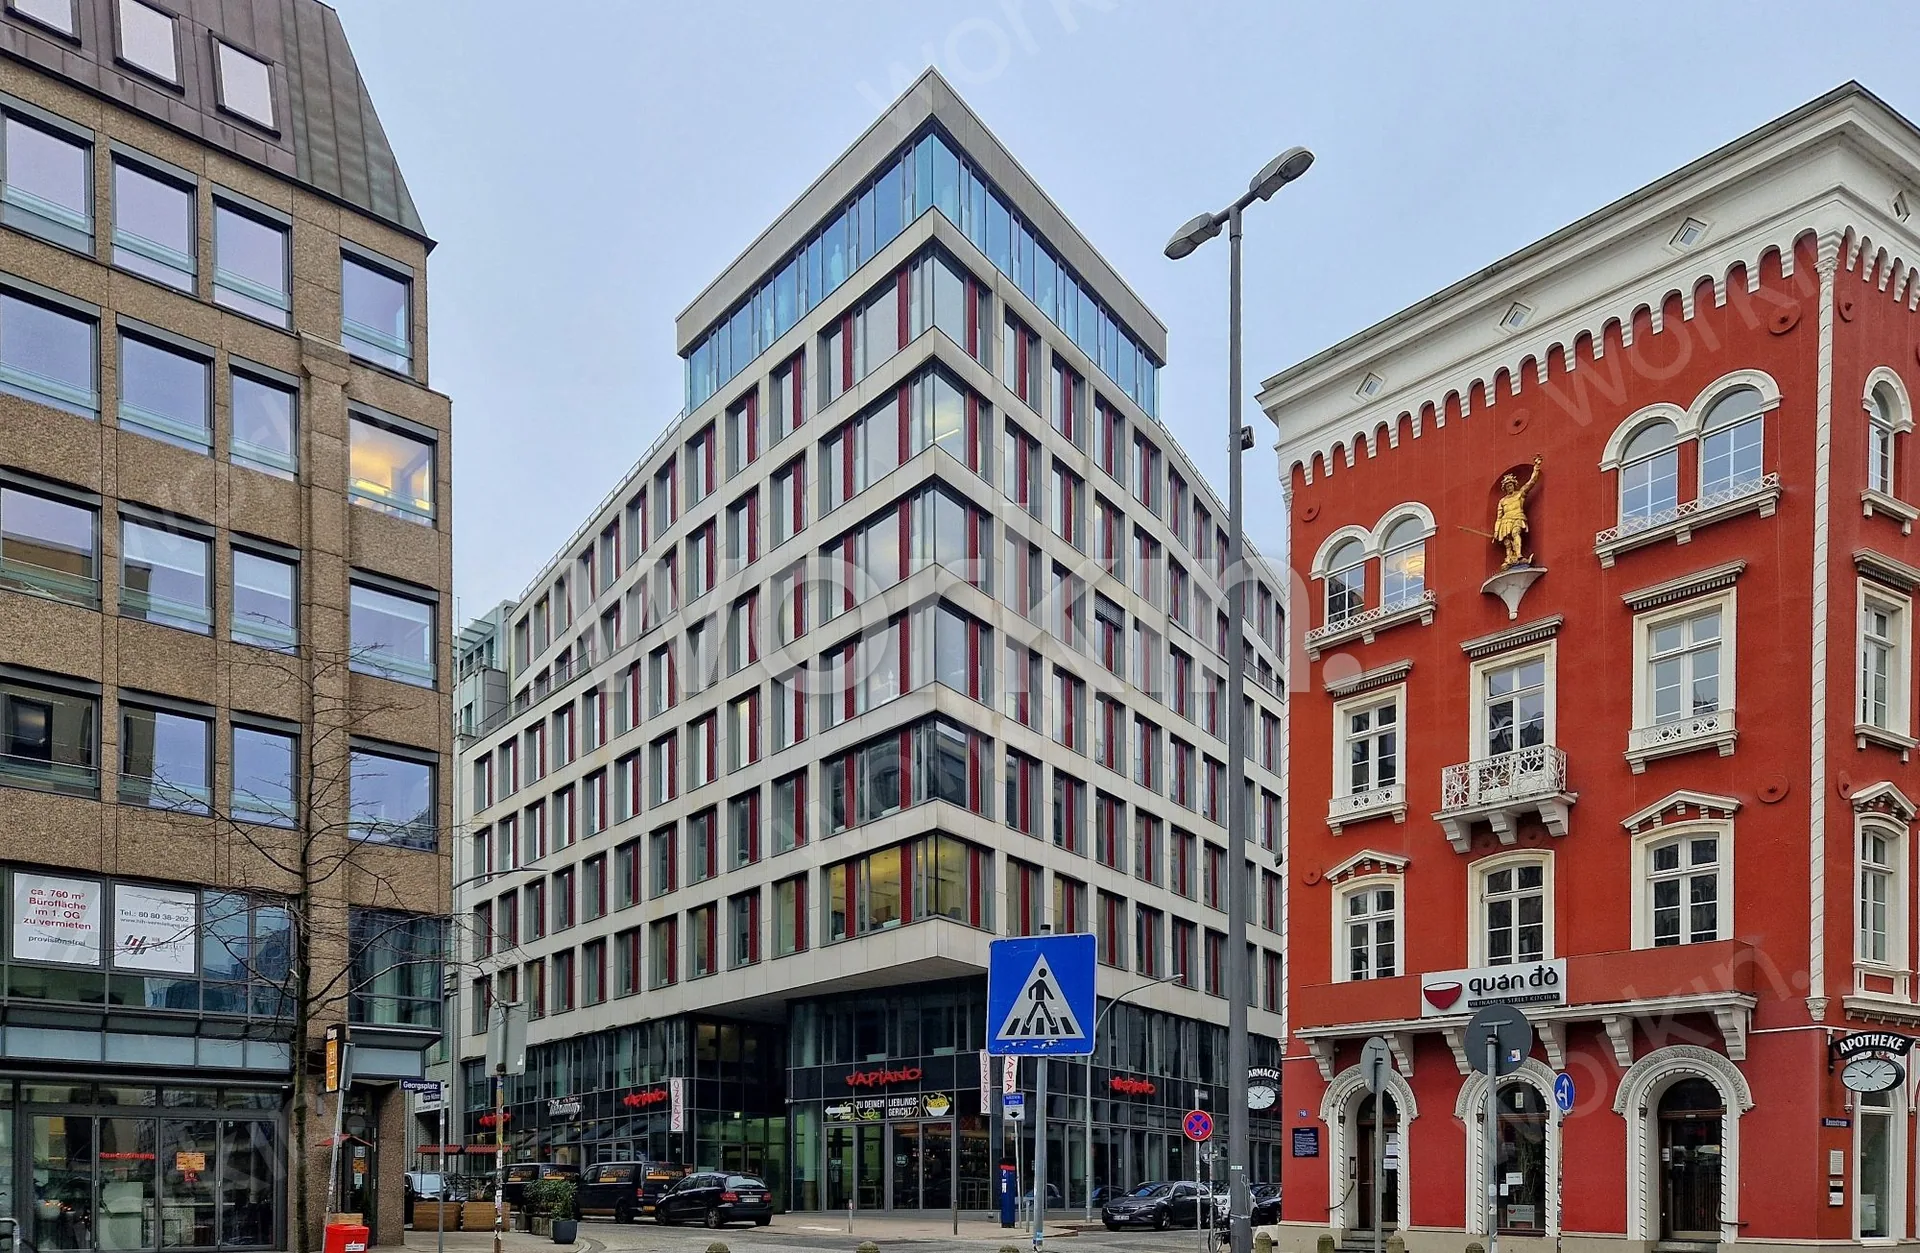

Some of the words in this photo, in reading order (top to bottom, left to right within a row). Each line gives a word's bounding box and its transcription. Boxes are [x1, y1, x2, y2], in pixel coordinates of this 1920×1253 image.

[30, 888, 47, 897] ca.
[50, 889, 69, 899] 760
[35, 908, 48, 916] im
[63, 910, 81, 920] OG
[23, 917, 36, 925] zu
[39, 918, 92, 930] vermieten
[1468, 973, 1524, 996] quán
[1507, 996, 1529, 1004] STREET
[1839, 1034, 1905, 1054] APOTHEKE
[846, 1066, 922, 1086] VAPIANO
[1248, 1068, 1281, 1080] ARMACIE
[402, 1081, 439, 1091] Georgsplatz
[856, 1101, 863, 1109] ZU
[864, 1099, 885, 1109] DEINEM
[888, 1097, 919, 1107] LIEBLINGS-
[888, 1108, 912, 1117] GERICHT
